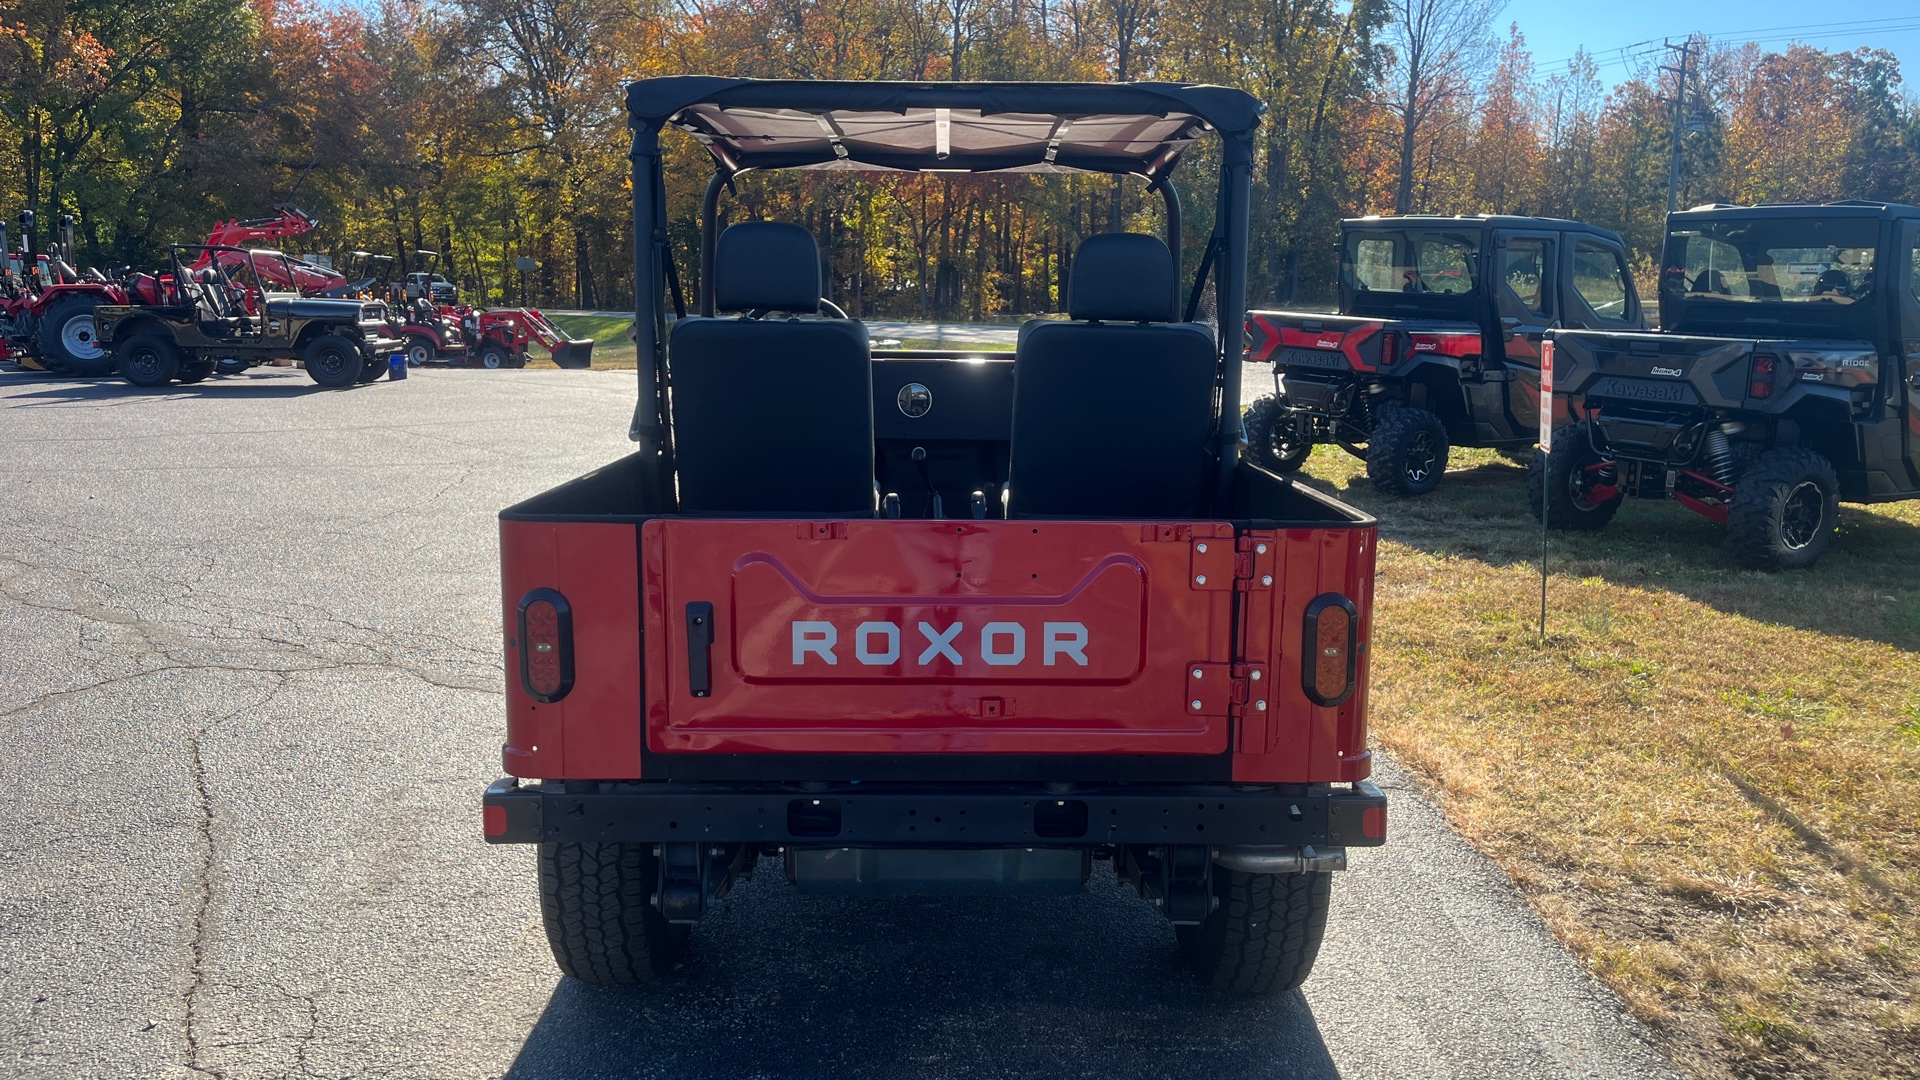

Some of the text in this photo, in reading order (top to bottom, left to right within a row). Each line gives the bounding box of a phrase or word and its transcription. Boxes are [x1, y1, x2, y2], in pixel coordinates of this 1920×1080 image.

[1287, 350, 1340, 367] Kawasaki
[1842, 359, 1870, 367] RIDGE
[1605, 379, 1684, 401] Kawasaki
[792, 621, 1088, 666] ROXOR
